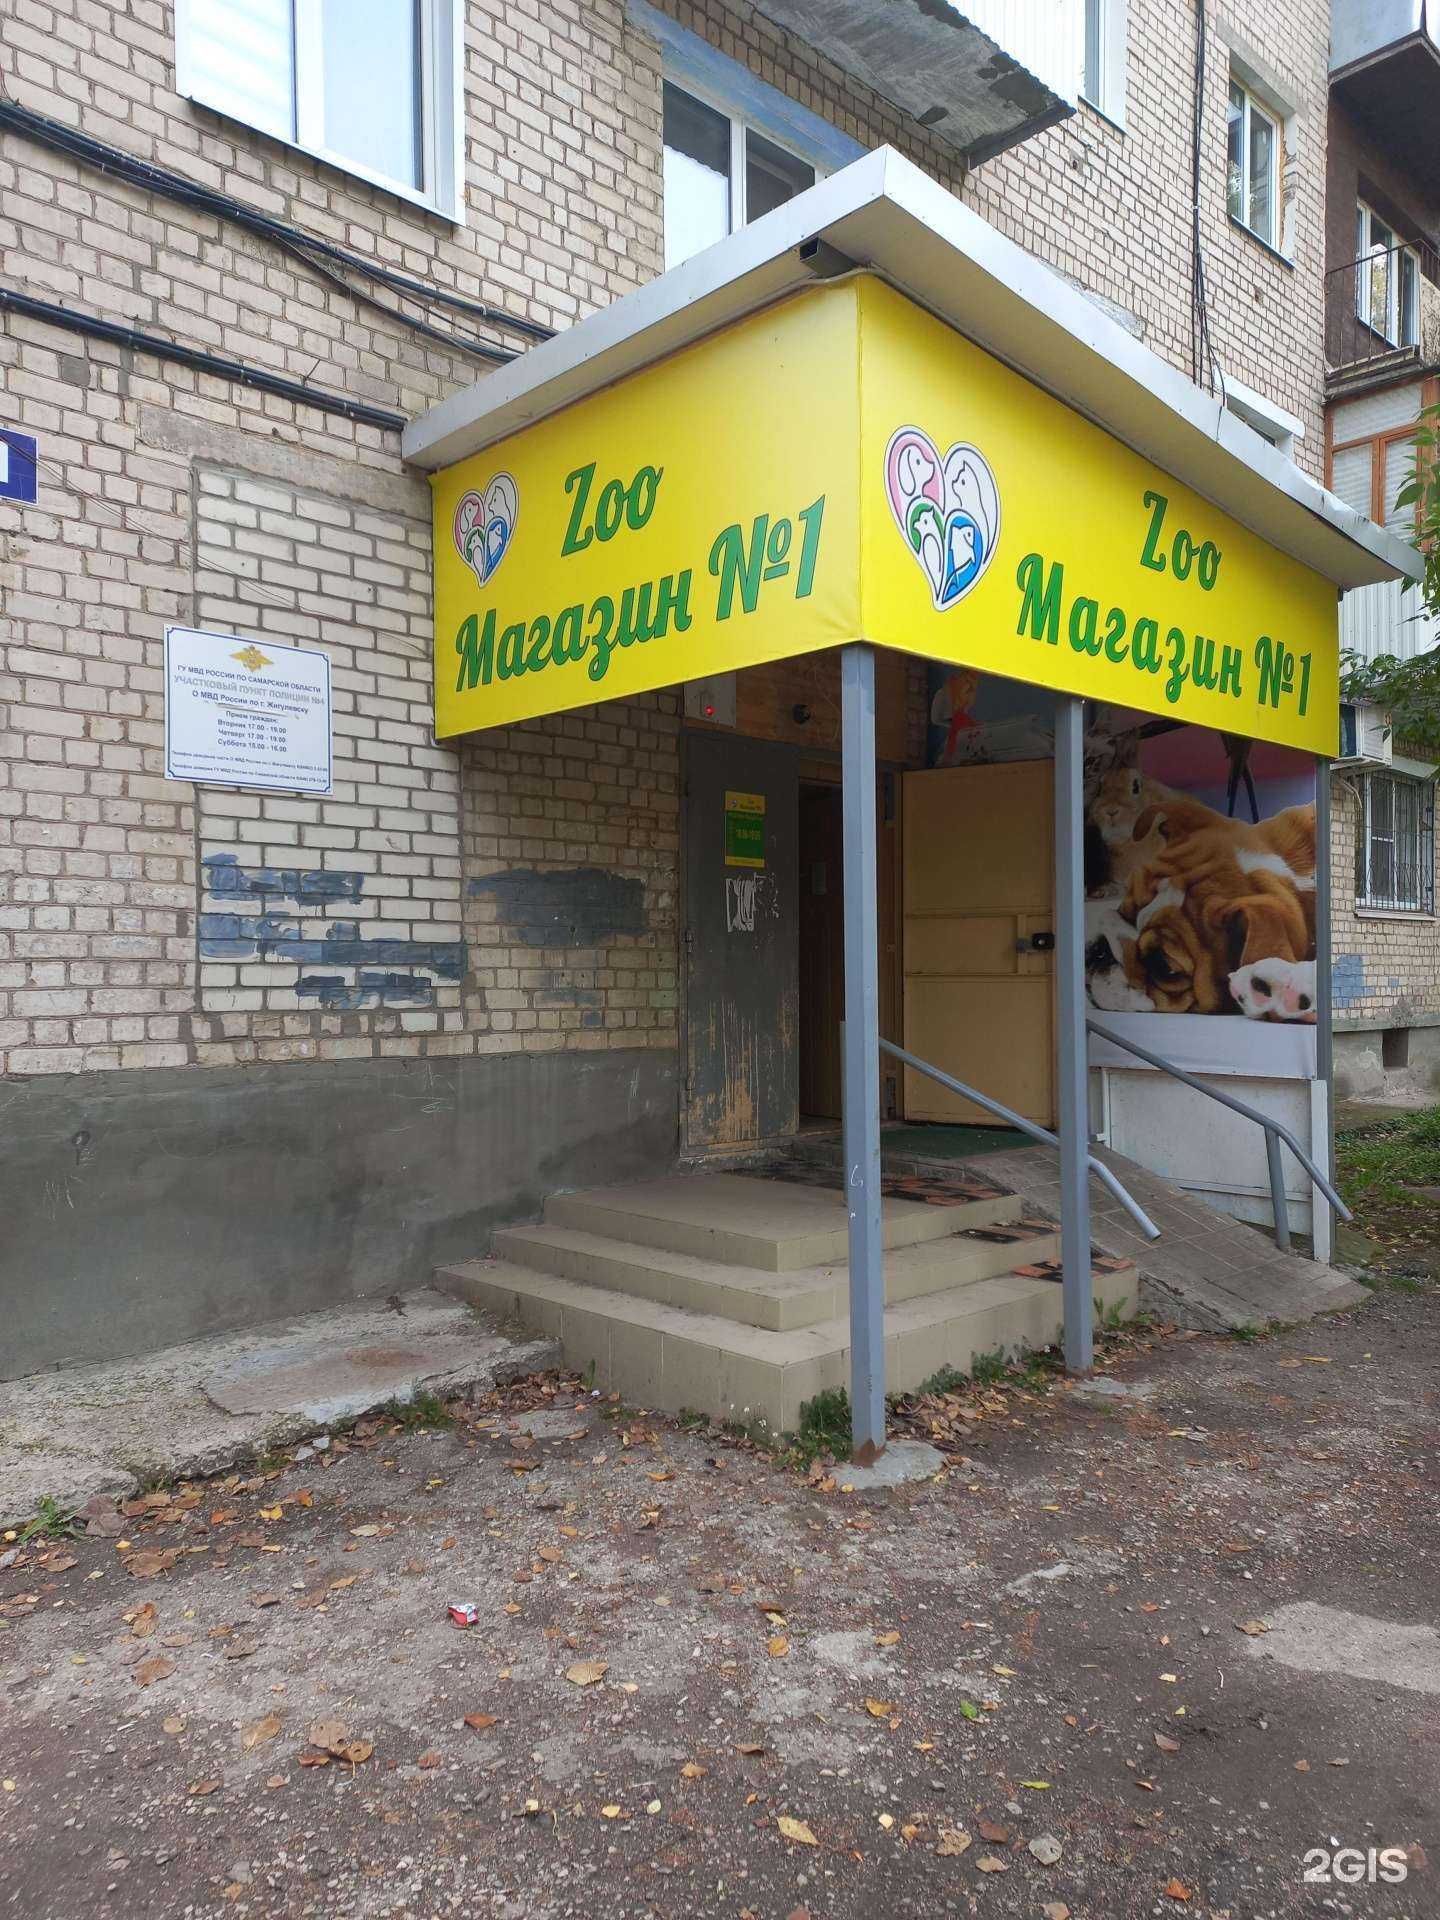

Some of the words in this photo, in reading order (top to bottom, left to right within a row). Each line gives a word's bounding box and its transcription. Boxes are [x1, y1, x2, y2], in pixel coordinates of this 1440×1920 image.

[560, 462, 664, 557] Zoo
[1140, 490, 1223, 592] Zoo
[455, 568, 693, 692] Магазин
[708, 494, 826, 621] №1
[1016, 552, 1244, 704] Магазин
[1254, 635, 1313, 717] №1
[174, 674, 237, 691] УЧАСТКОВЫЙ
[239, 684, 267, 697] ПУНКТ
[269, 690, 310, 703] ПОЛИЦИИ
[187, 666, 204, 675] МВД
[205, 669, 235, 680] РОССИИ
[236, 674, 247, 682] ПО
[248, 676, 289, 688] САМАРСКОЙ
[290, 682, 321, 693] ОБЛАСТИ
[200, 691, 219, 701] МВД
[220, 694, 248, 705] России
[217, 738, 247, 748] Суббота
